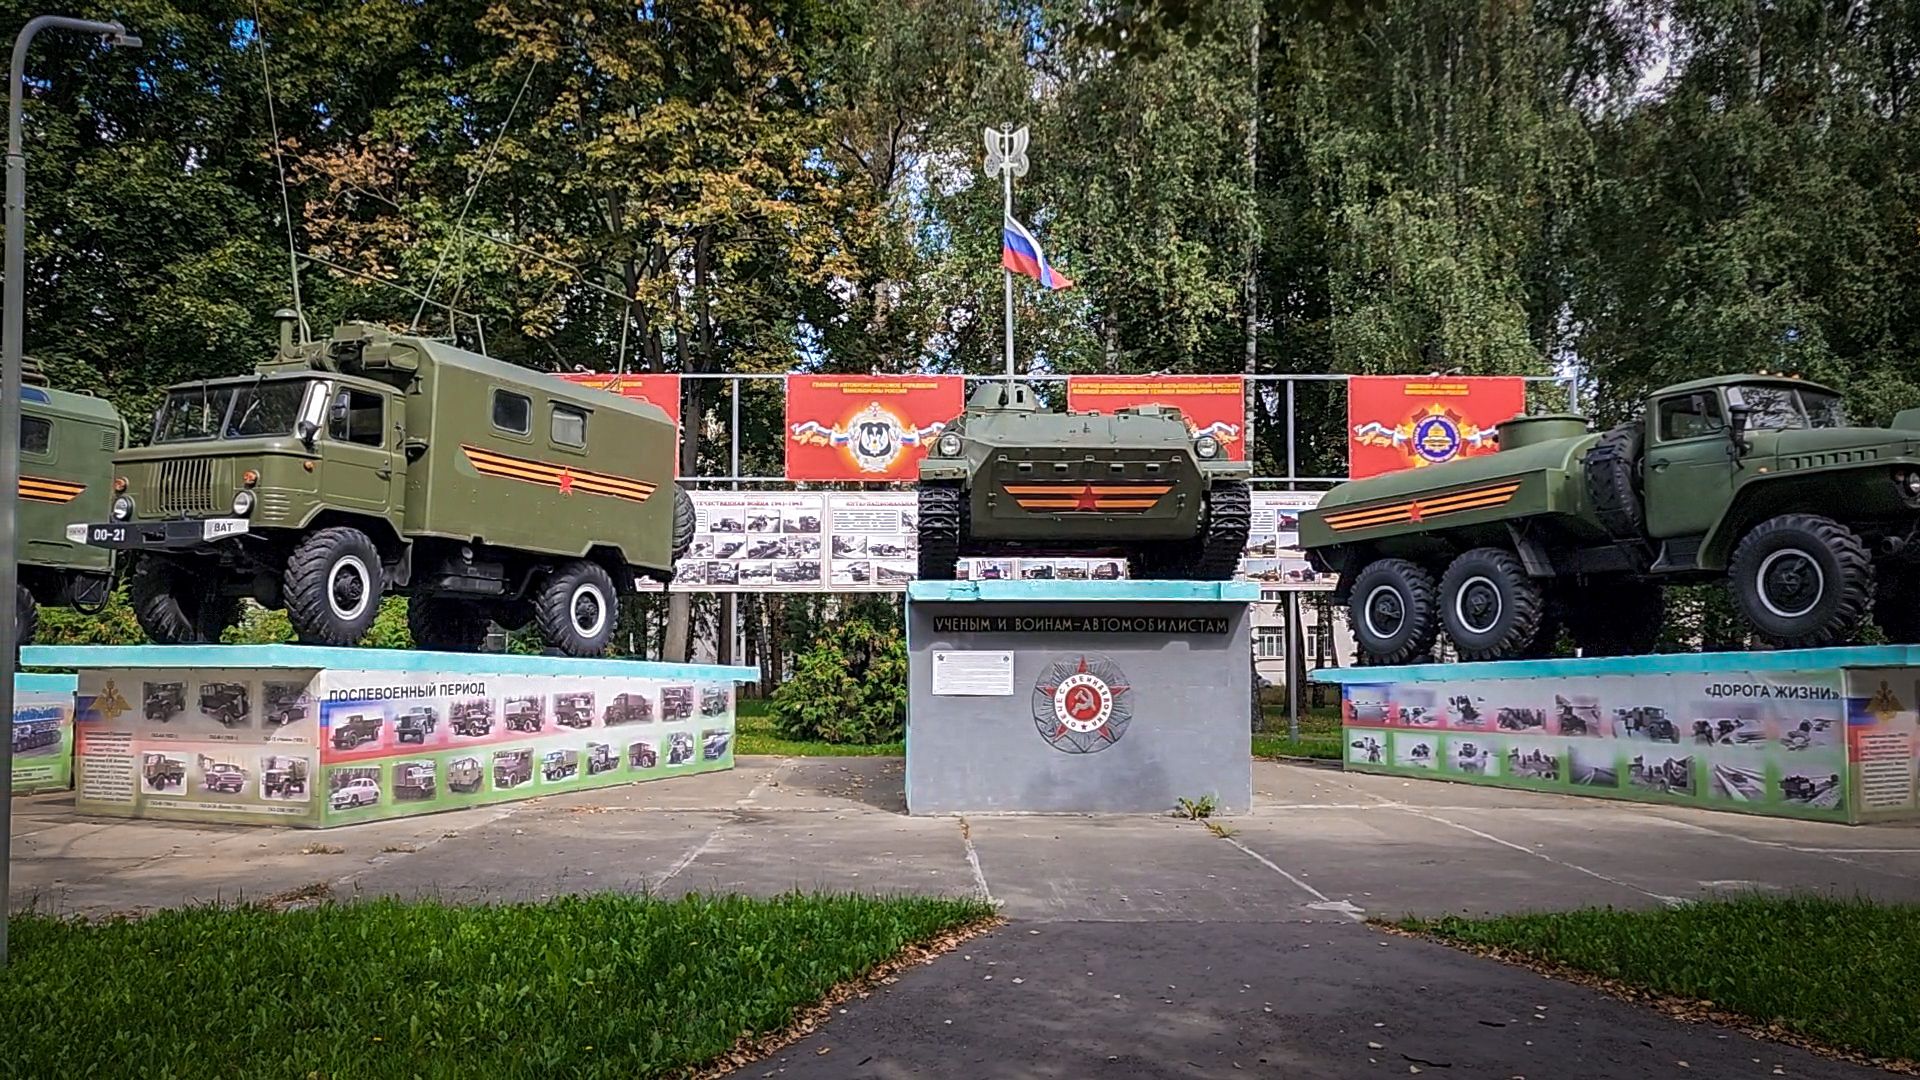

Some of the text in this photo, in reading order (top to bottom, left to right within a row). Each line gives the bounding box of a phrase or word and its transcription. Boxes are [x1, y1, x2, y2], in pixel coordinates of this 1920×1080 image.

[94, 528, 126, 541] 00-21
[214, 522, 233, 532] ВАТ
[936, 616, 1228, 633] УЧЕНЫМ И ВОИНАМ-АВТОМОБИЛИСТАМ
[329, 682, 486, 703] ПОСЛЕВОЕННЫЙ ПЕРИОД
[1705, 683, 1840, 700] «ДОРОГА ЖИЗНИ»
